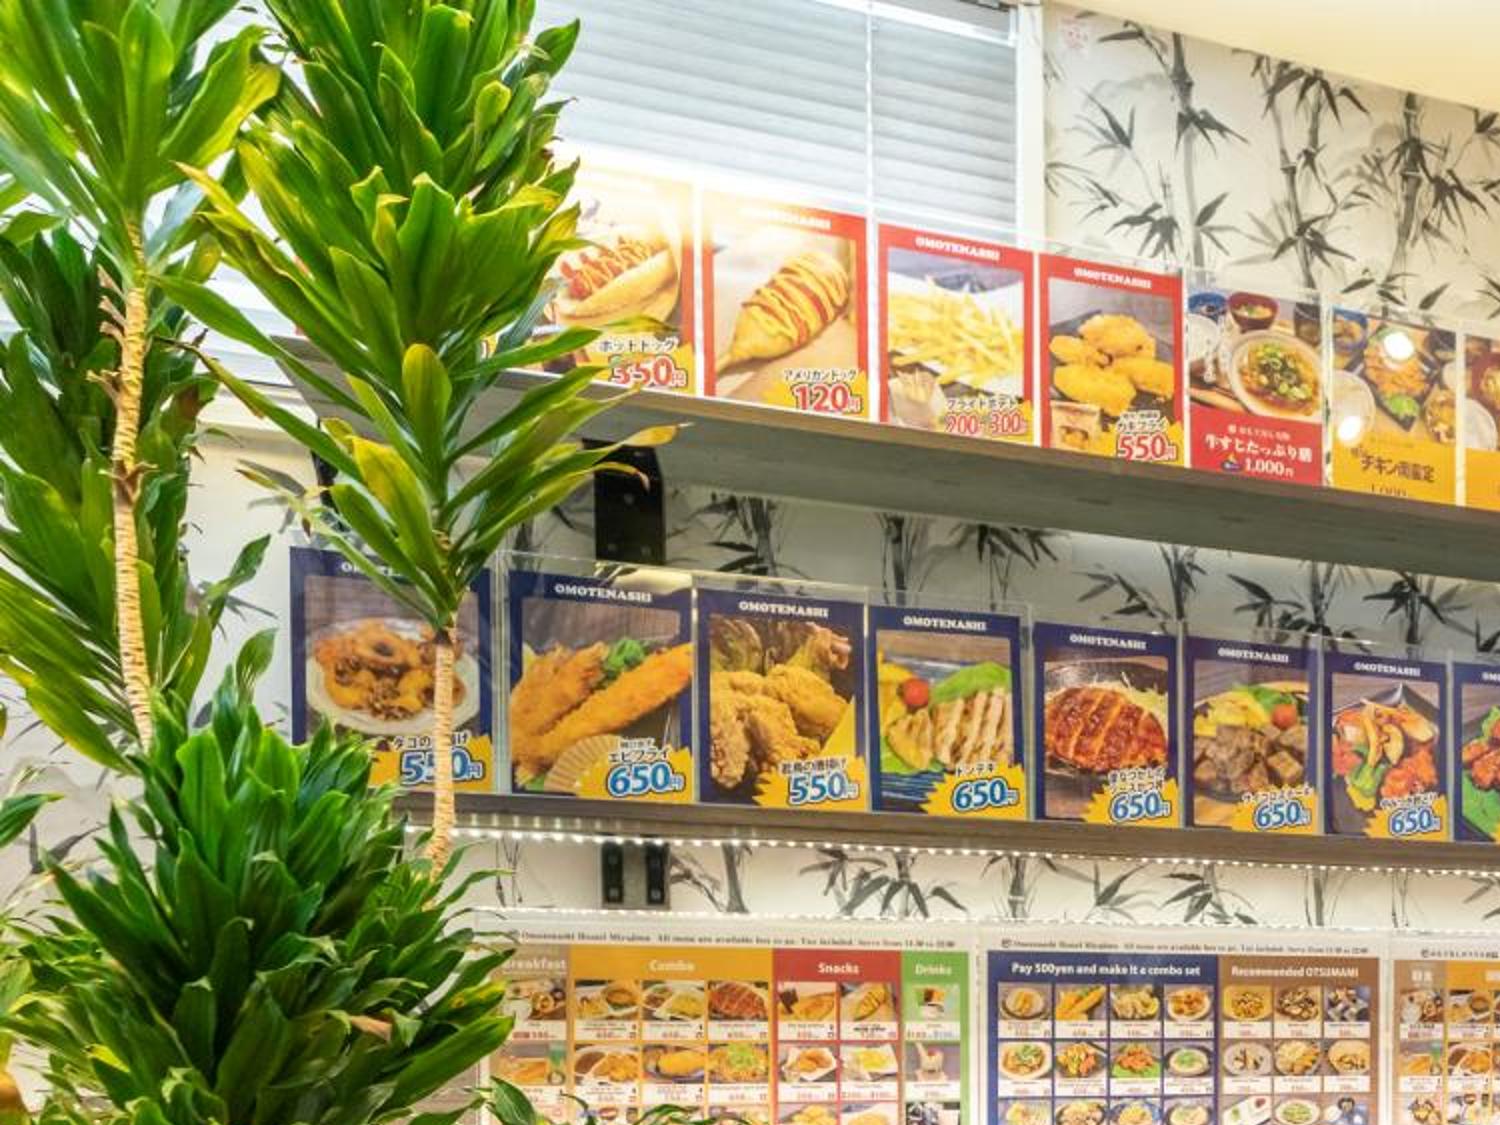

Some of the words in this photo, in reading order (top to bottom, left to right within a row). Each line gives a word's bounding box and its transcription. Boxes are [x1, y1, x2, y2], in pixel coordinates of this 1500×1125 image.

[555, 583, 652, 602] OMOTENASHI
[739, 600, 829, 618] OMOTENASHI
[904, 616, 987, 631] OMOTENASHI
[1070, 634, 1146, 650] OMOTENASHI
[1218, 648, 1289, 663] OMOTENASHI
[818, 961, 860, 975] Snacks
[1012, 962, 1032, 976] Pay
[1076, 962, 1097, 975] and
[1099, 963, 1127, 975] make
[1148, 963, 1182, 976] combo
[1185, 964, 1200, 976] set
[1231, 965, 1304, 978] Recommended
